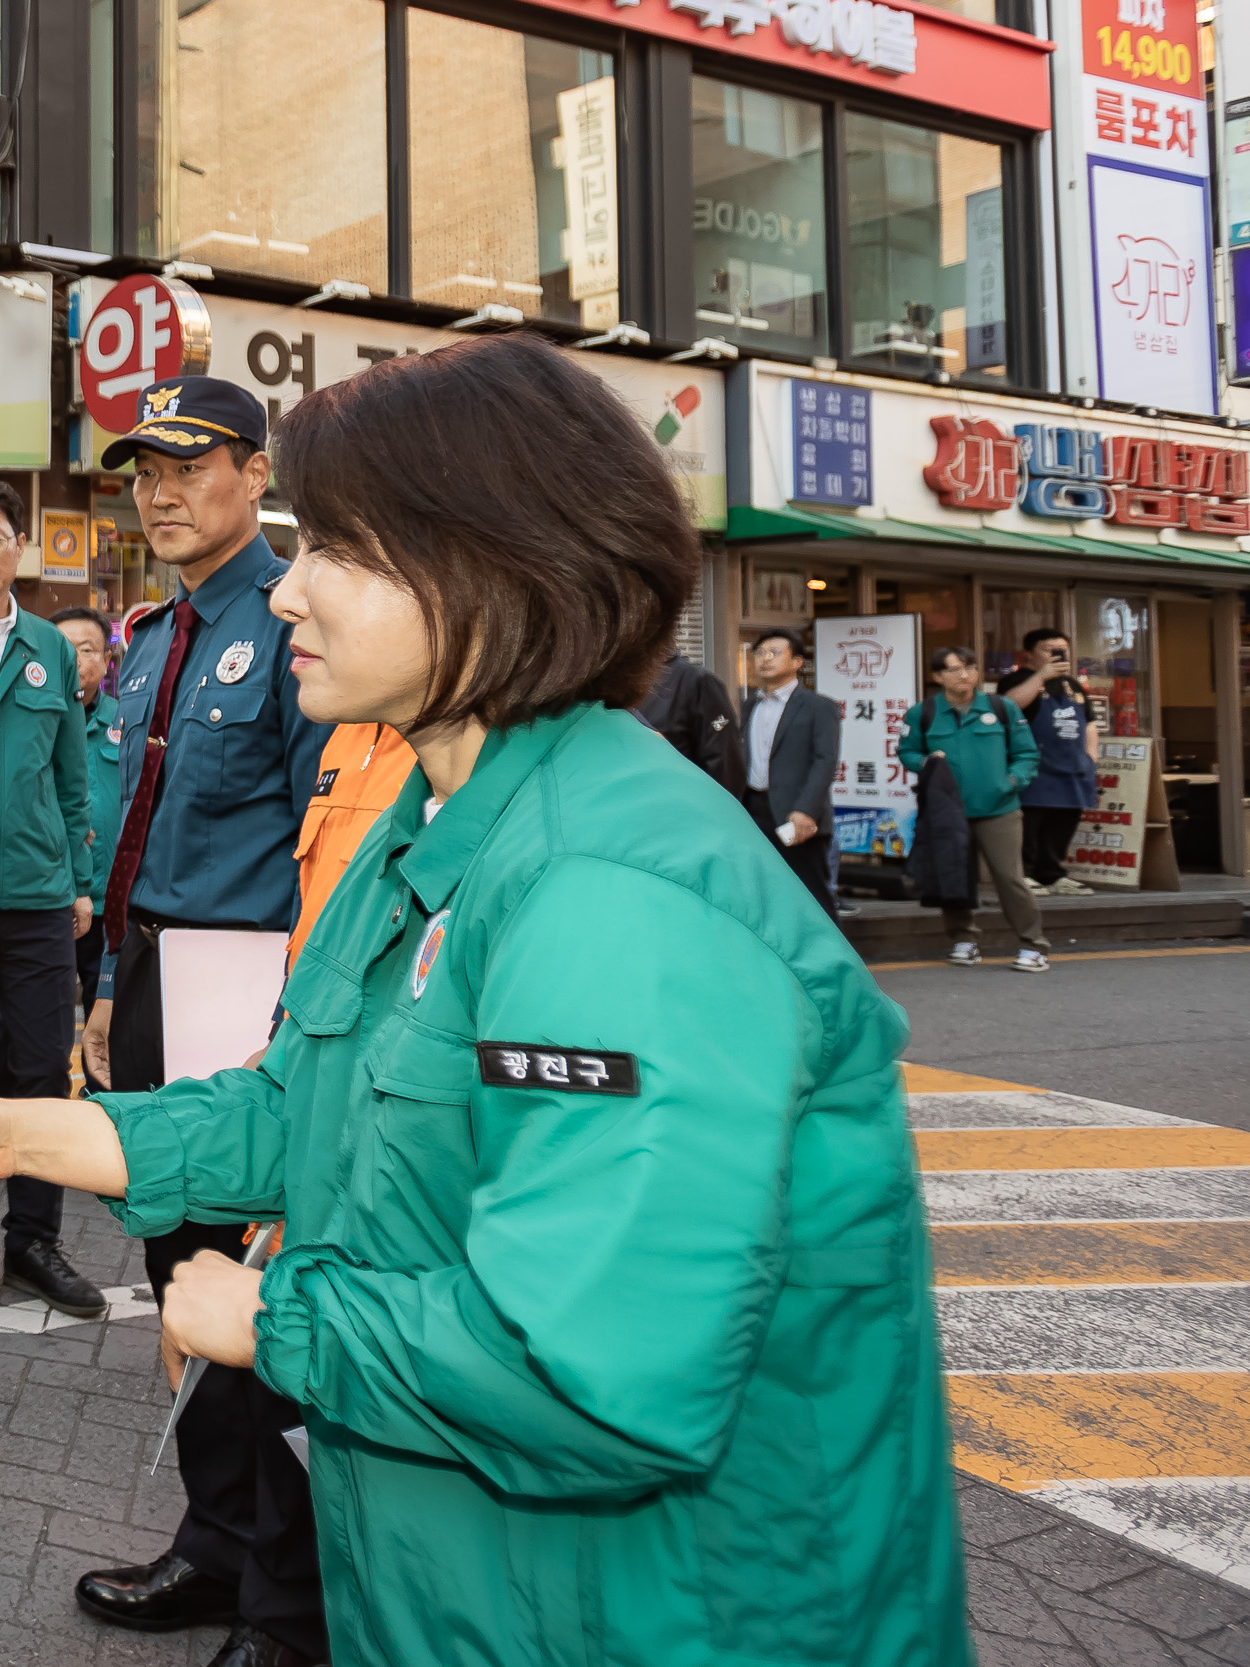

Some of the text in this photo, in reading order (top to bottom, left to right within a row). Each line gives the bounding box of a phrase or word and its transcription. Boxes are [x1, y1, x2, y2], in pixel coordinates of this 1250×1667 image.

[1096, 25, 1192, 85] 14,900
[1096, 88, 1197, 158] 룸포차
[86, 285, 172, 400] 약
[1133, 330, 1178, 356] 냉삼집
[500, 1049, 610, 1087] 광진구
